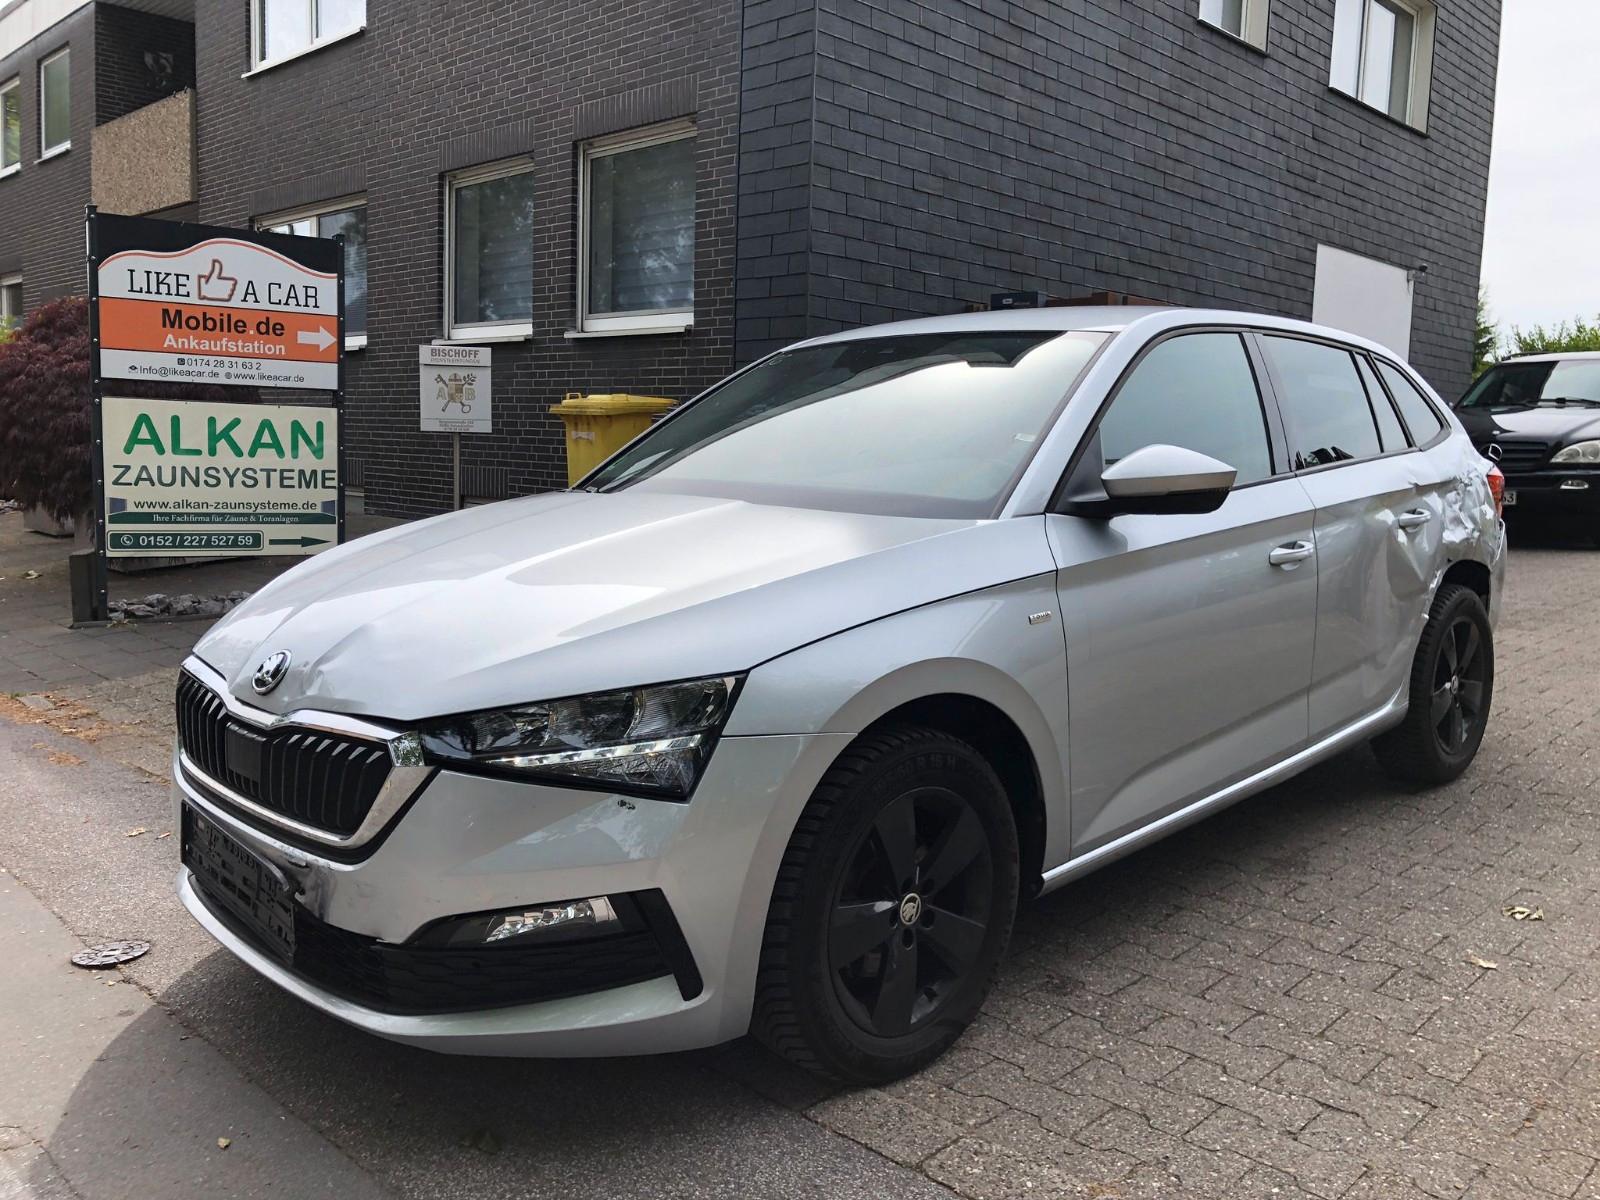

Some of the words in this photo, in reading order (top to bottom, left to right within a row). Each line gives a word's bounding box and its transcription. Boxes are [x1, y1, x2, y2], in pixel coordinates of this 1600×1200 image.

[128, 269, 190, 297] LIKE
[241, 281, 260, 303] A
[268, 282, 320, 309] CAR
[161, 308, 285, 337] Mobile.de
[163, 333, 286, 355] Ankaufstation
[431, 349, 479, 358] BISCHOFF
[186, 357, 210, 367] 0174
[213, 359, 225, 369] 28
[227, 360, 239, 369] 31
[241, 361, 253, 370] 63
[255, 362, 262, 370] 2
[139, 366, 220, 378] Info@likeacar.de
[233, 372, 305, 383] www.likeacar.de
[123, 413, 324, 460] ALKAN
[112, 464, 337, 490] ZAUNSYSTEME
[133, 499, 317, 512] www.alkan-zaunsysteme.de
[153, 514, 170, 522] Ihre
[171, 514, 210, 522] Fachfirma
[259, 515, 299, 524] Toranlagen
[139, 535, 173, 546] 0152
[183, 535, 208, 546] 227
[211, 536, 234, 546] 527
[237, 536, 253, 546] 59
